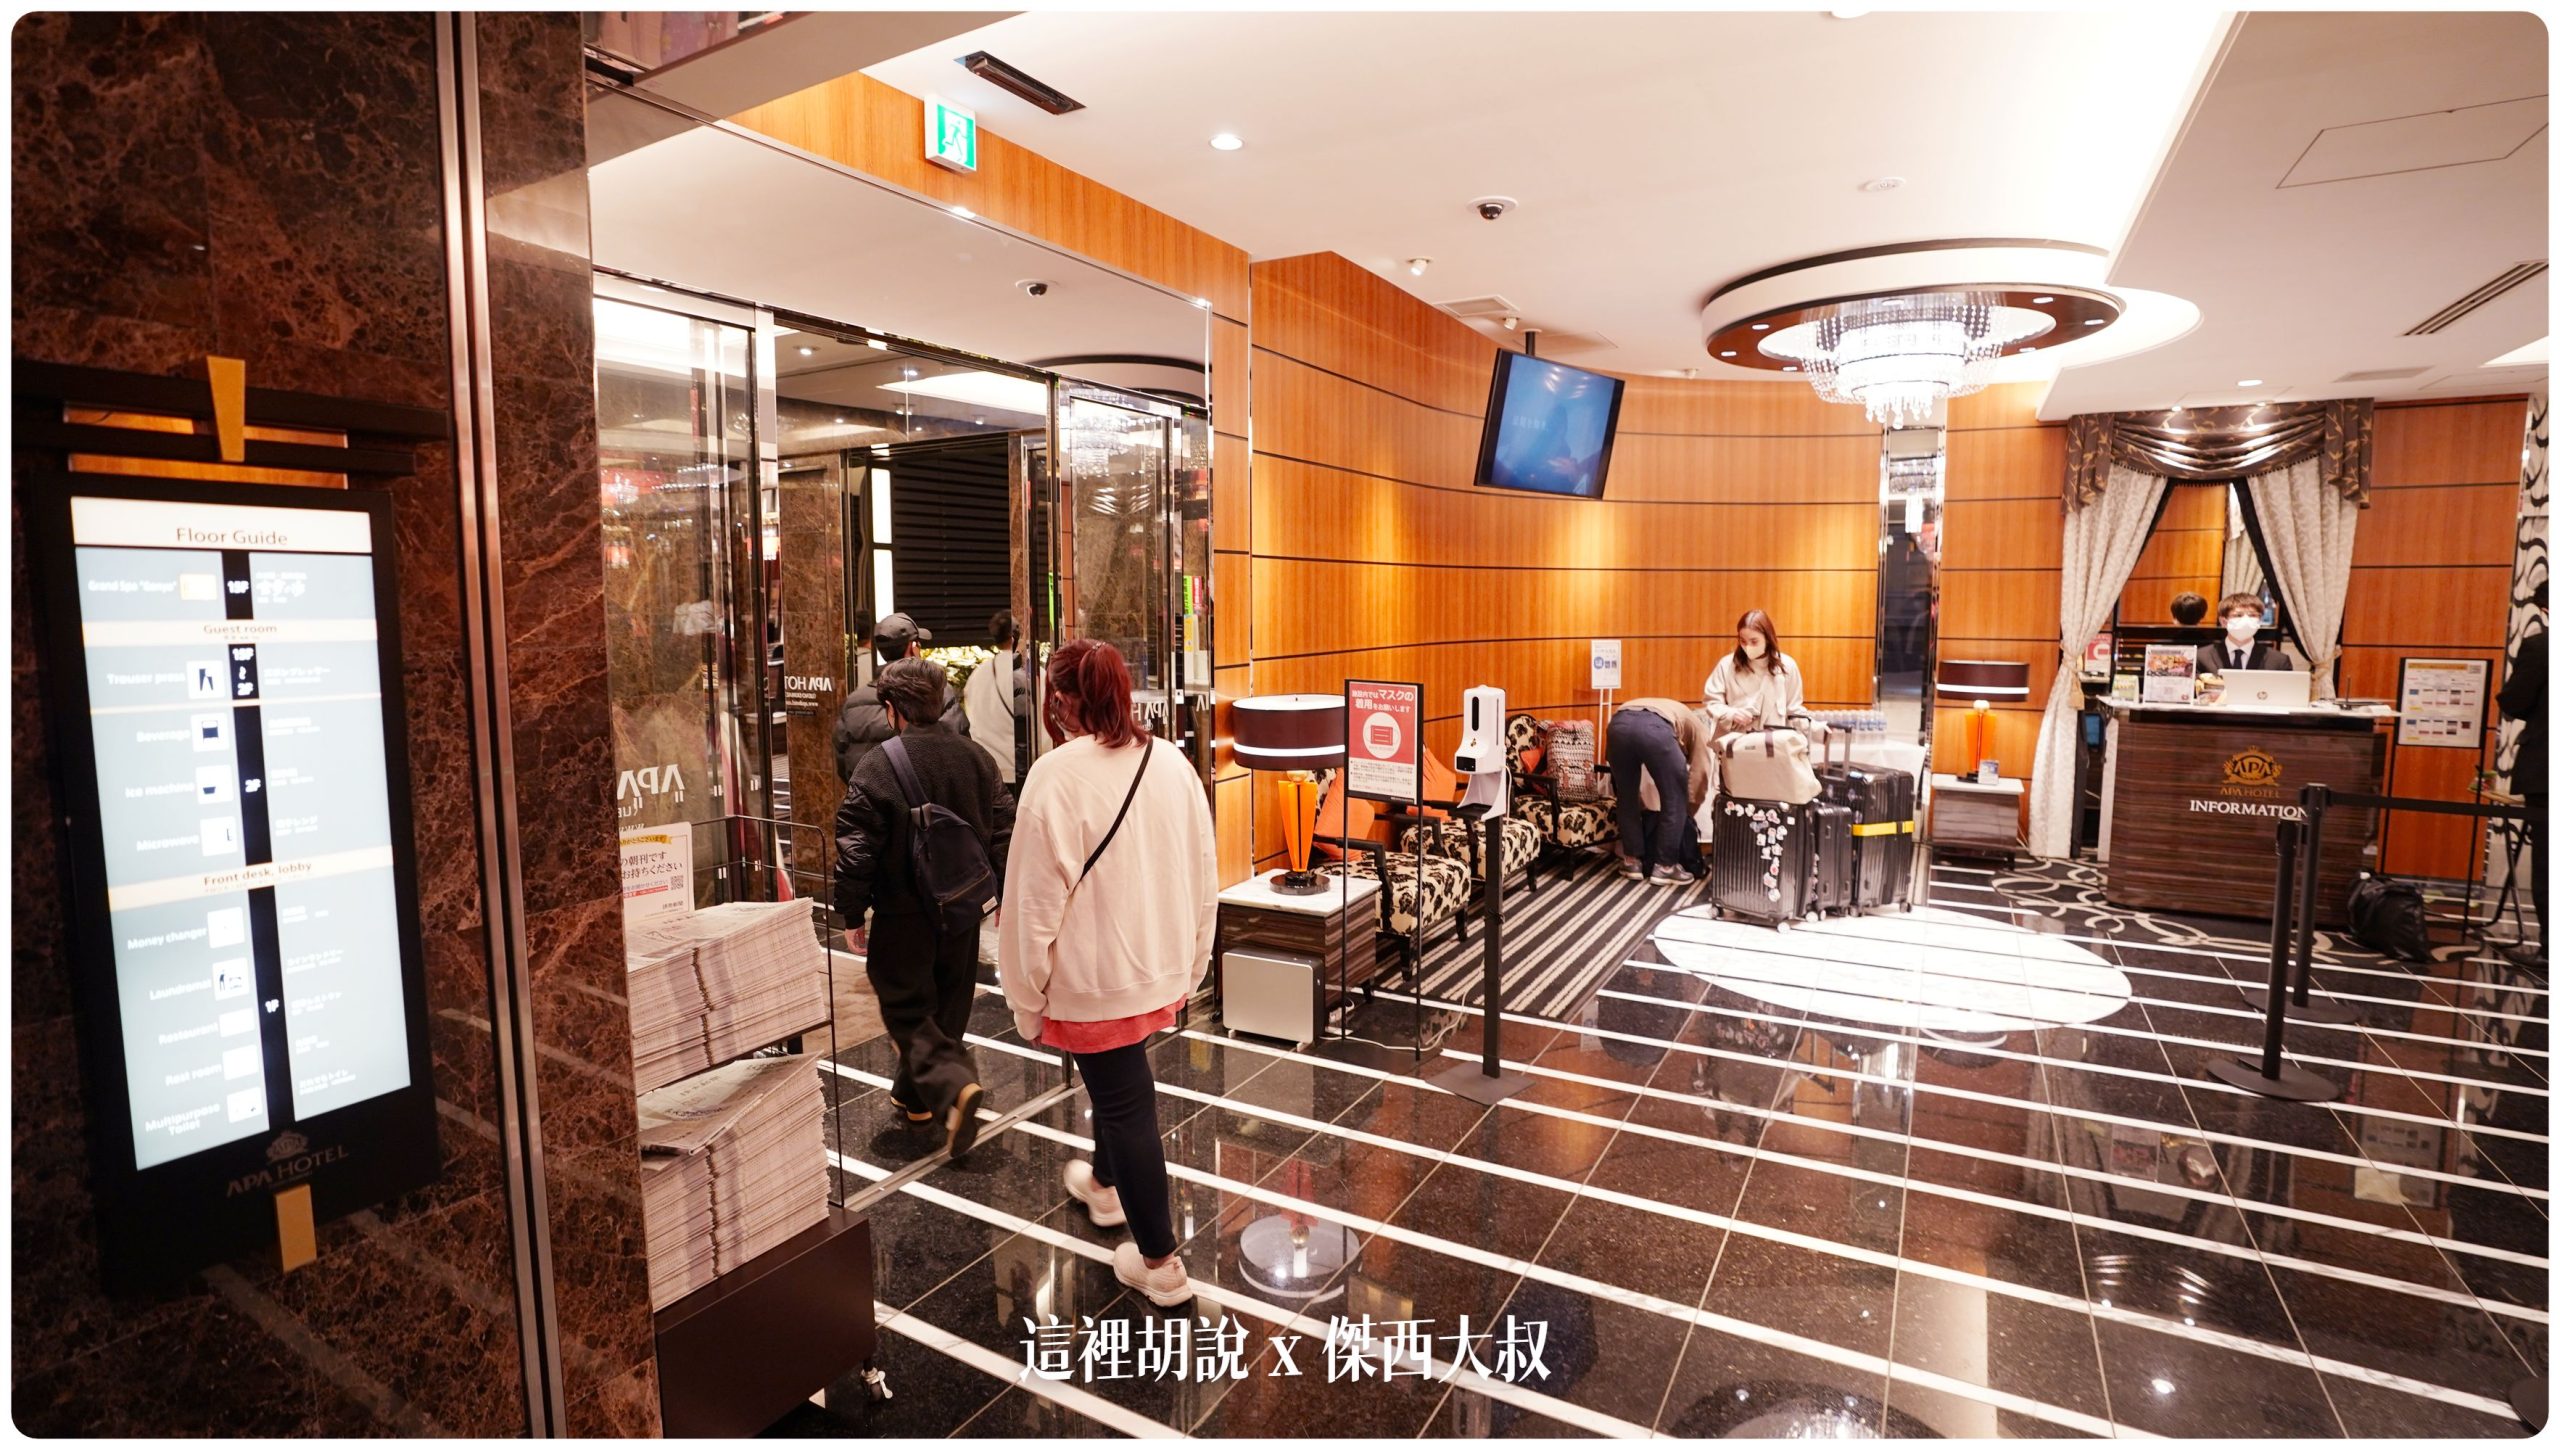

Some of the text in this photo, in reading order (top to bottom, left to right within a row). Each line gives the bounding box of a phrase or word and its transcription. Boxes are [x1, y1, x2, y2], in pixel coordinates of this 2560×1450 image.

[176, 527, 288, 546] Floor Guide
[203, 624, 278, 635] Guest room
[106, 672, 153, 685] Trouser
[136, 729, 191, 744] Beverage
[2220, 785, 2280, 798] APA HOTEL
[136, 834, 199, 852] Microwave
[203, 873, 239, 886] Front
[242, 868, 275, 880] desk,
[278, 862, 312, 874] lobby
[127, 927, 208, 950] Money changer
[149, 979, 212, 1001] Laundromat
[158, 1022, 218, 1046] Restaurant
[165, 1064, 222, 1087] Rest room
[145, 1103, 221, 1133] Multipurpose
[168, 1119, 201, 1137] Toilet
[227, 1170, 273, 1198] APA
[277, 1145, 350, 1179] HOTEL
